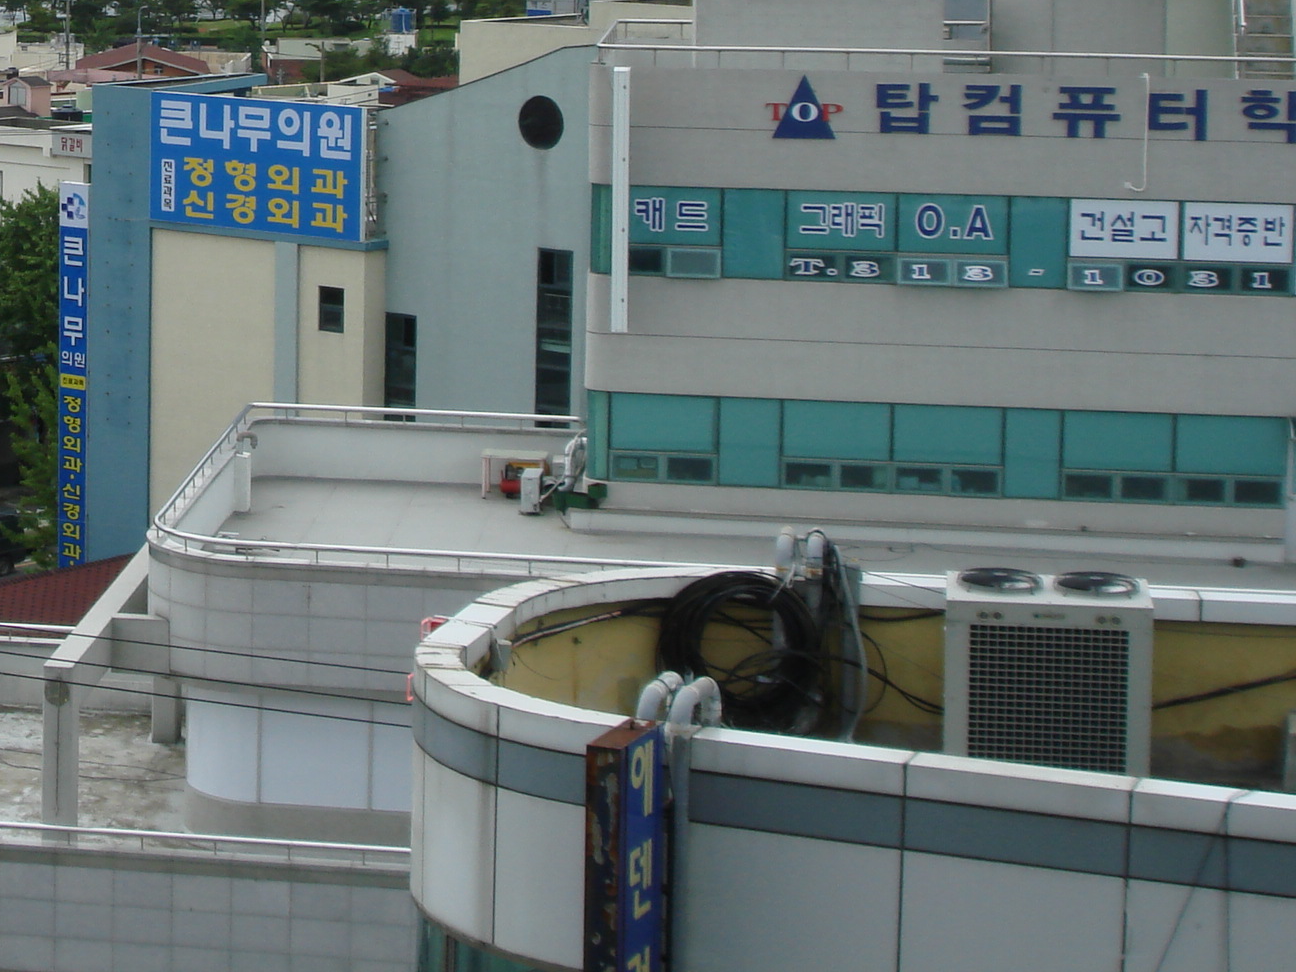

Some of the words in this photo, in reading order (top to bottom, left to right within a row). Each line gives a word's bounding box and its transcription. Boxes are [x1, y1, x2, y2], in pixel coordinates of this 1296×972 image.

[159, 99, 353, 161] 큰나무의원
[183, 156, 349, 200] 정형외과
[182, 190, 349, 234] 신경외과
[634, 196, 708, 233] 캐드
[799, 201, 885, 239] 그래픽
[1079, 211, 1168, 243] 건설고
[1189, 213, 1286, 247] 자격증반
